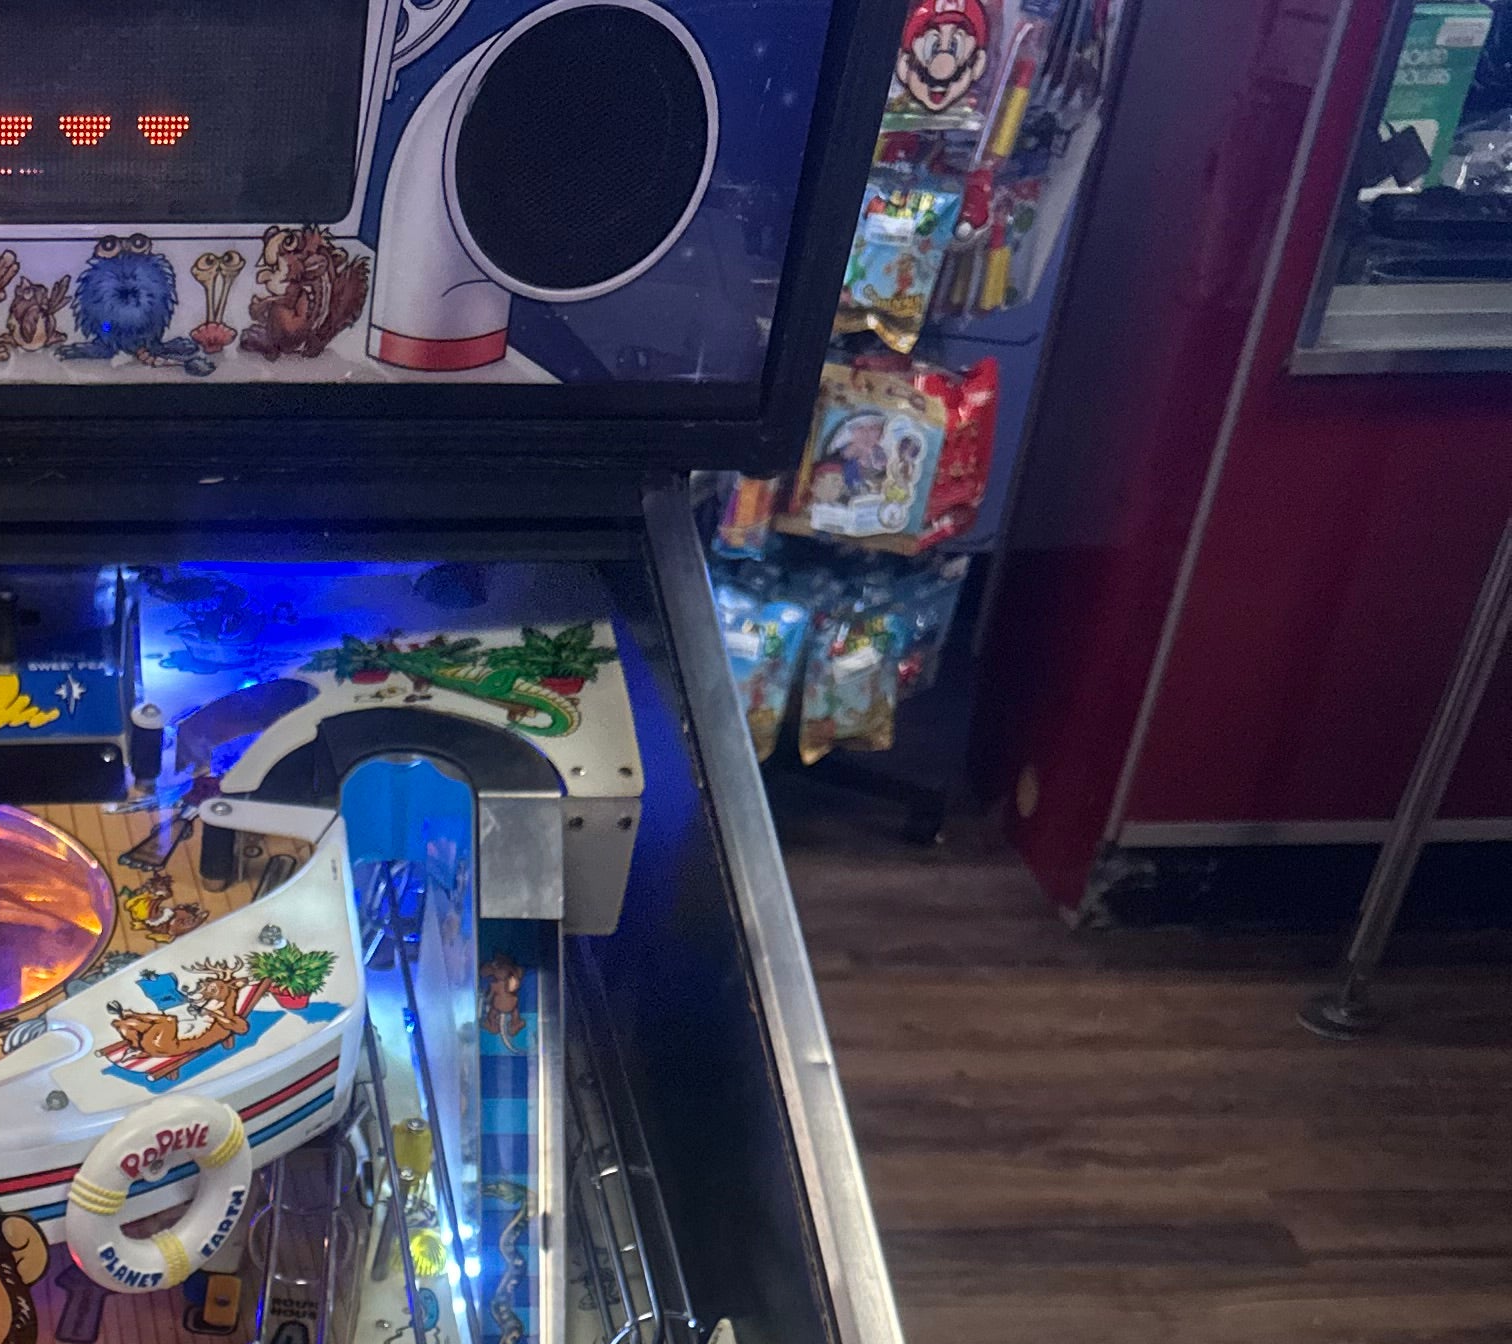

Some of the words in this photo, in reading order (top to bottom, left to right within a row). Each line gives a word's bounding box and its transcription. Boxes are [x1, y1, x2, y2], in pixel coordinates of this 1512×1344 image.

[120, 1122, 209, 1179] POPEYE
[99, 1246, 163, 1287] PLANET
[201, 1189, 246, 1258] EARTH
